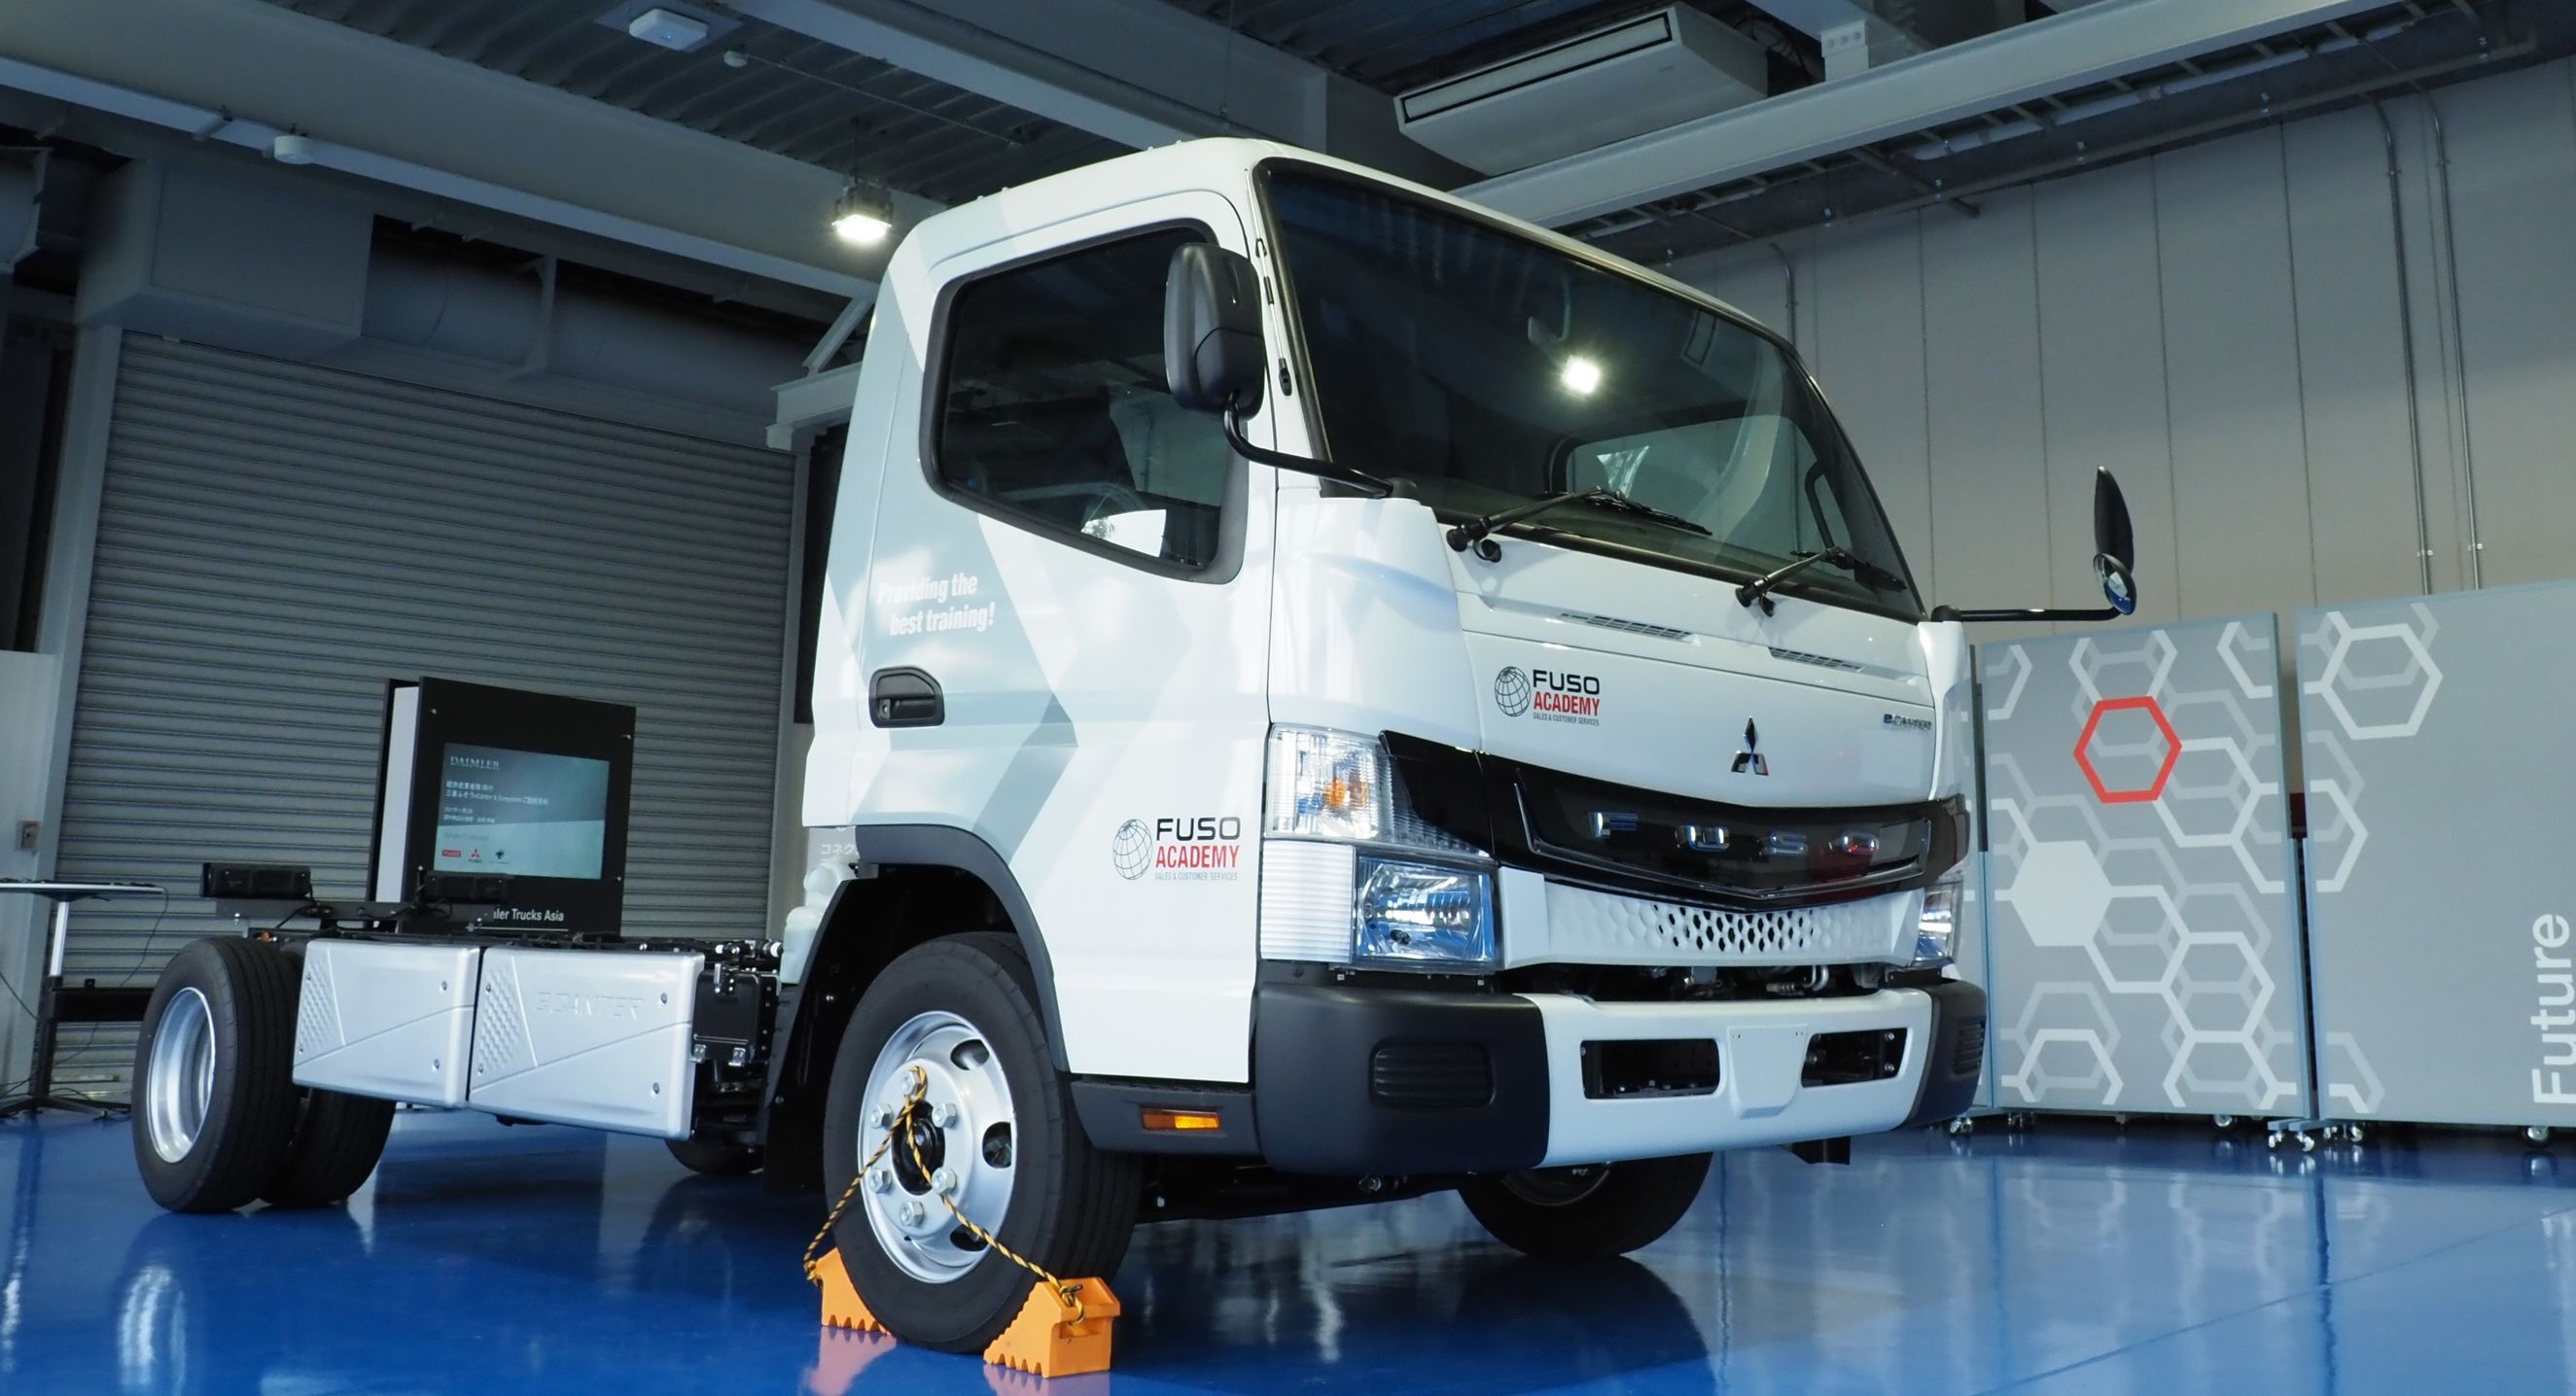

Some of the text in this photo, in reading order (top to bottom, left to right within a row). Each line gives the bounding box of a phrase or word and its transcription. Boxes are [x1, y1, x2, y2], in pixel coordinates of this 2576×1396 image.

[878, 572, 978, 604] Providing the
[889, 602, 995, 636] best training!
[1533, 669, 1601, 695] FUSO
[1533, 691, 1601, 716] ACADEMY
[1533, 712, 1548, 720] SALES
[1155, 816, 1241, 842] FUSO
[1589, 811, 1880, 856] FUSO
[1155, 845, 1241, 869] ACADEMY
[1154, 872, 1172, 881] SALES
[1178, 872, 1208, 882] CUSTOMER
[1210, 872, 1238, 881] SERVICES
[511, 907, 543, 921] Trucks
[544, 908, 565, 922] Asia
[2530, 913, 2576, 1104] Future
